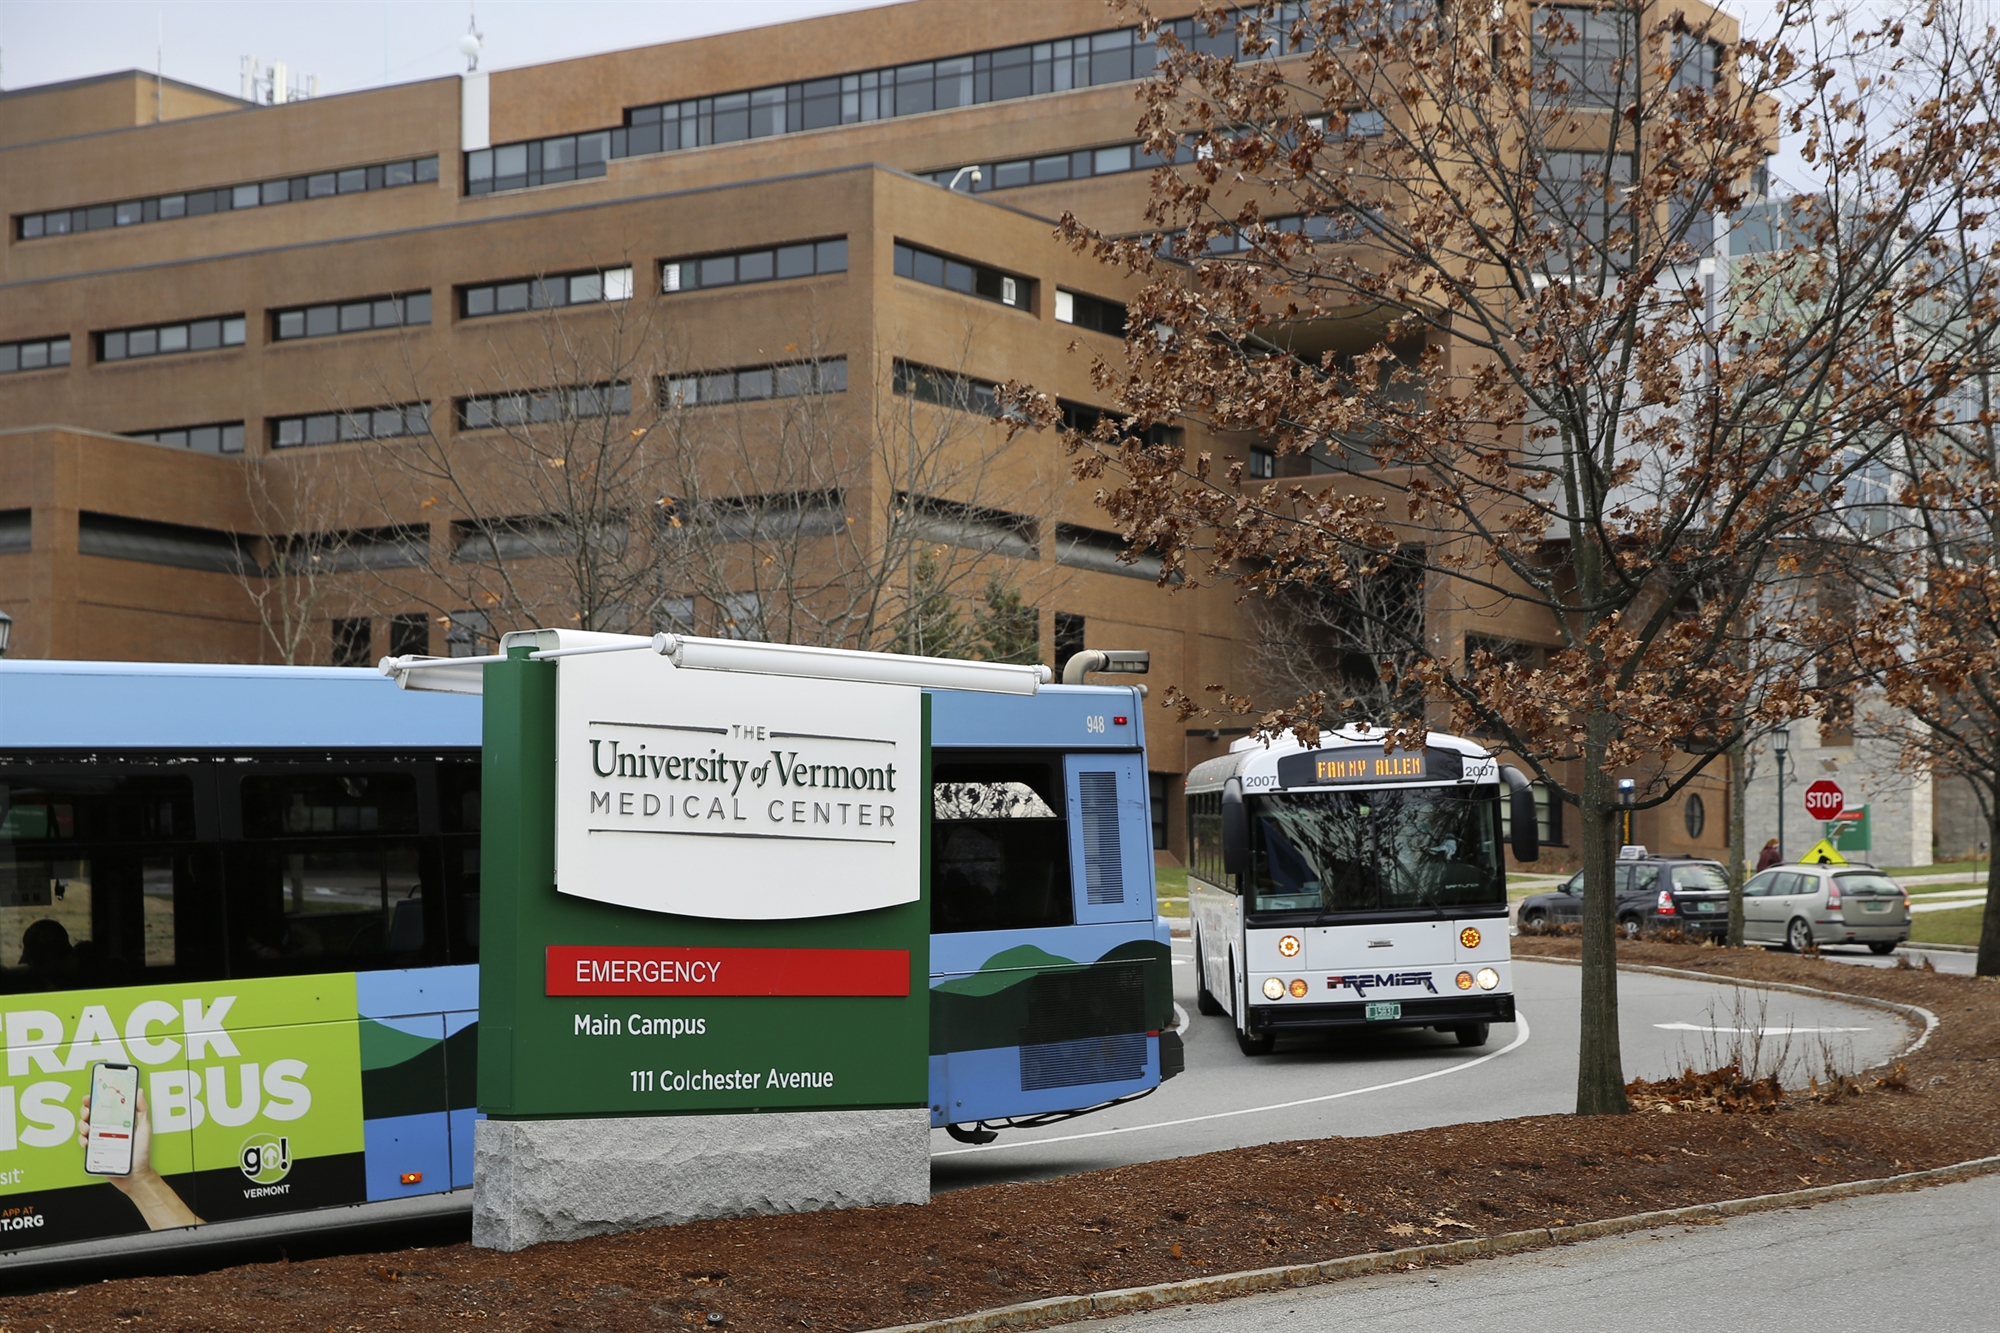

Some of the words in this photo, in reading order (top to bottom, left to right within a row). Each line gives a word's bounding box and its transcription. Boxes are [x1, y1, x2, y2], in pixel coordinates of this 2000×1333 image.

[732, 724, 766, 741] THE
[1086, 715, 1105, 734] 948
[589, 739, 749, 797] University
[750, 759, 772, 789] of
[770, 750, 897, 793] Vermont
[1317, 760, 1366, 779] FANNY
[1375, 758, 1421, 776] ALLEN
[1465, 765, 1495, 777] 2007
[1246, 775, 1277, 788] 2007
[590, 790, 748, 821] MEDICAL
[767, 799, 896, 828] CENTER
[1806, 791, 1842, 809] STOP
[576, 960, 722, 983] EMERGENCY
[0, 995, 241, 1077] RACK
[574, 1013, 622, 1036] Main
[627, 1013, 707, 1039] Campus
[630, 1070, 654, 1092] 111
[659, 1069, 761, 1092] Colchester
[766, 1068, 834, 1090] Avenue
[150, 1058, 312, 1135] BUS
[243, 1184, 290, 1199] VERMONT
[2, 1208, 21, 1217] APP
[23, 1205, 34, 1215] AT
